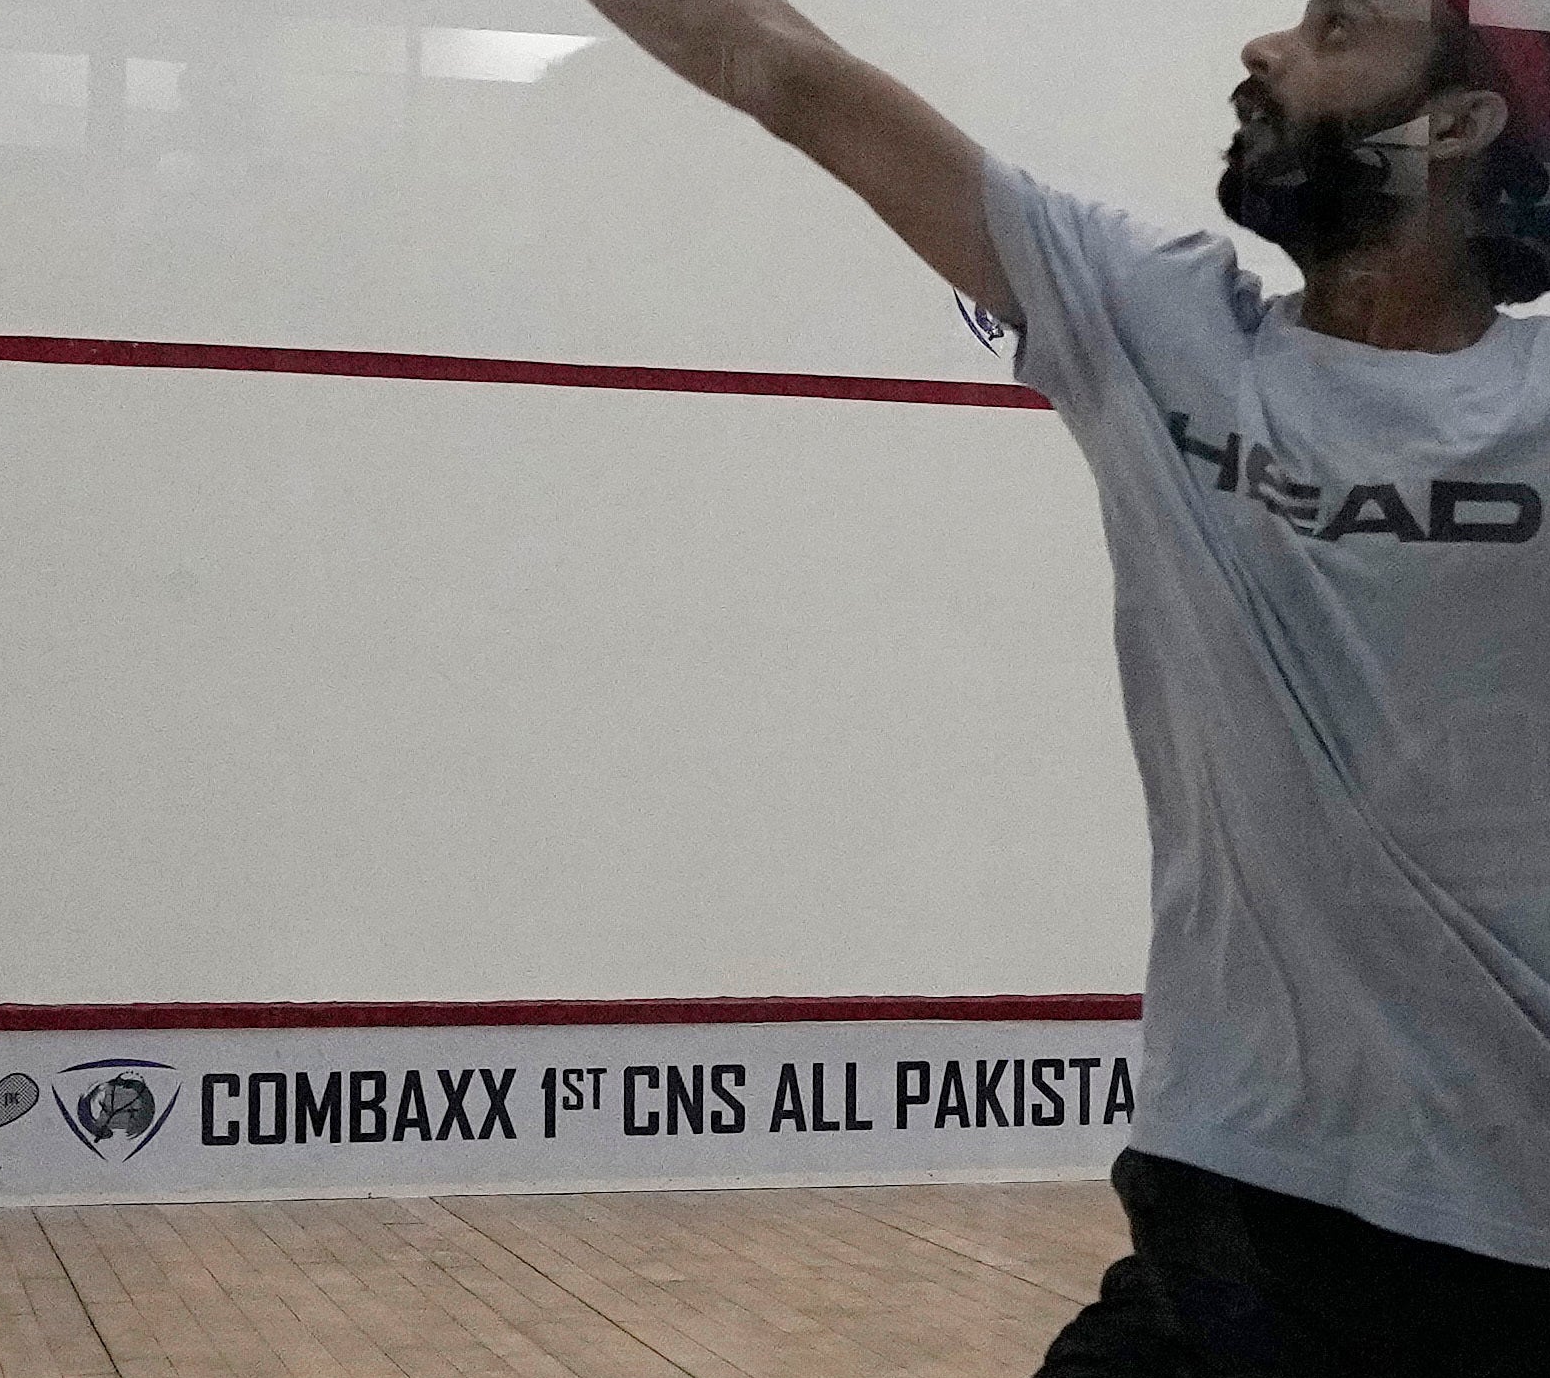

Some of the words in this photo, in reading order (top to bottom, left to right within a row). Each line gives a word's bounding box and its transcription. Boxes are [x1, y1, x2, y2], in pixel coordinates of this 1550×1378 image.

[1166, 412, 1543, 543] HEAD
[202, 1067, 517, 1146] COMBAXX
[541, 1067, 607, 1138] 1ST
[623, 1063, 746, 1136] CNS
[769, 1061, 873, 1132] ALL
[897, 1056, 1136, 1130] PAKISTA
